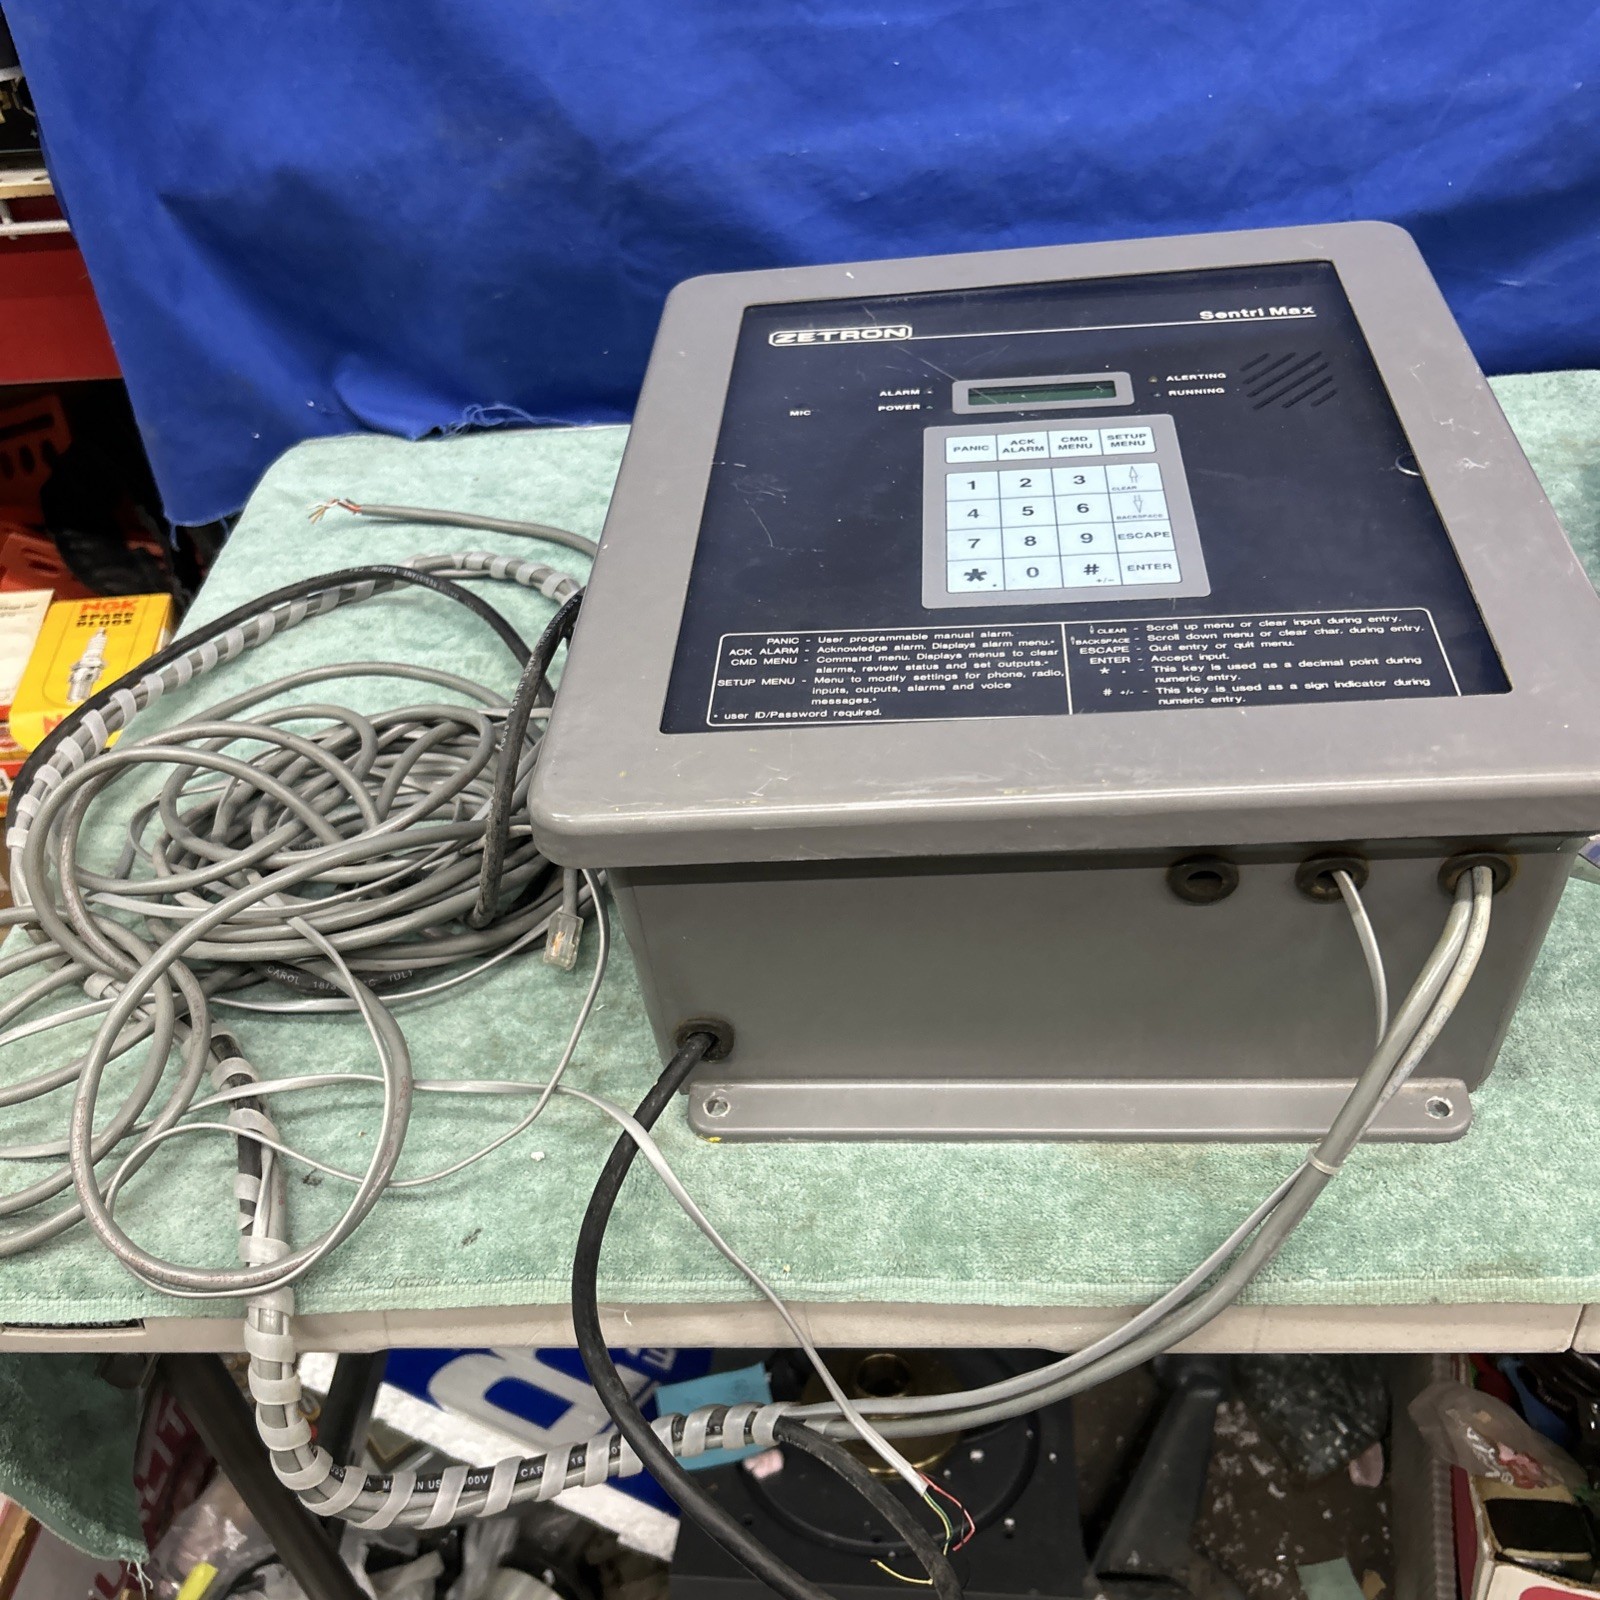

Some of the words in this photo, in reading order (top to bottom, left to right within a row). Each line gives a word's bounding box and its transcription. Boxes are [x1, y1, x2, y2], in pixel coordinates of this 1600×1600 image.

[1200, 308, 1264, 320] Sentri
[1268, 306, 1315, 316] Max
[774, 327, 907, 344] ZETRON
[1166, 372, 1227, 382] ALERTING
[879, 389, 920, 397] ALARM
[1168, 388, 1225, 396] RUNNING
[878, 404, 920, 412] POWER
[1110, 440, 1146, 448] MENU
[1002, 446, 1045, 454] ALARM
[967, 480, 976, 490] 1
[1019, 478, 1032, 488] 2
[1073, 475, 1086, 484] 3
[967, 508, 980, 518] 4
[1022, 506, 1034, 516] 5
[1077, 504, 1089, 514] 6
[1024, 536, 1037, 546] 8
[1080, 533, 1093, 544] 9
[1118, 531, 1171, 540] ESCAPE
[968, 538, 981, 548] 7
[1026, 566, 1039, 578] 0
[1083, 564, 1100, 576] #
[1127, 563, 1172, 572] ENTER
[81, 600, 137, 613] NGK
[1146, 624, 1178, 632] Scroll
[1204, 622, 1234, 630] menu
[1293, 618, 1321, 626] input
[1328, 616, 1362, 625] during
[1368, 615, 1401, 624] entry.
[818, 636, 844, 644] User
[850, 632, 928, 644] programmable
[934, 632, 974, 640] manual
[980, 630, 1014, 638] alarm.
[1076, 638, 1130, 646] BACKSPACE
[1147, 634, 1180, 642] Scroll
[1186, 632, 1217, 640] down
[1260, 630, 1272, 638] or
[1278, 629, 1308, 637] clear
[1314, 628, 1343, 636] char.
[1349, 626, 1384, 635] during
[1390, 624, 1424, 634] entry.
[760, 647, 800, 655] ALARM
[817, 644, 888, 654] Acknowledge
[932, 642, 976, 650] Displays
[982, 640, 1013, 648] alarm
[1080, 646, 1130, 655] ESCAPE
[1149, 644, 1172, 652] Quit
[1178, 643, 1208, 652] entry
[1234, 641, 1254, 650] quit
[1260, 640, 1295, 648] menu.
[730, 658, 757, 666] CMD
[763, 657, 798, 665] MENU
[816, 655, 872, 664] Command
[878, 654, 910, 662] menu.
[916, 651, 962, 660] Displays
[1012, 650, 1024, 658] to
[1090, 656, 1130, 664] ENTER
[1151, 654, 1193, 663] Accept
[1198, 653, 1230, 662] input.
[816, 666, 856, 674] alarms,
[862, 664, 898, 672] review
[905, 662, 940, 670] status
[1152, 664, 1182, 672] This
[1182, 664, 1204, 673] key
[1227, 662, 1256, 670] used
[1298, 659, 1344, 668] decimal
[1350, 658, 1380, 666] point
[1386, 656, 1422, 665] during
[717, 678, 756, 686] SETUP
[761, 678, 796, 686] MENU
[814, 676, 844, 684] Menu
[851, 676, 862, 684] to
[868, 674, 906, 682] modify
[913, 672, 958, 681] settings
[965, 672, 980, 680] for
[987, 670, 1026, 680] phone,
[1155, 675, 1200, 684] numeric
[1206, 674, 1241, 682] entry.
[812, 686, 849, 695] inputs,
[856, 686, 901, 694] outputs,
[907, 684, 946, 692] alarms
[952, 682, 974, 690] and
[981, 682, 1012, 690] voice
[1102, 688, 1112, 696] #
[1156, 686, 1185, 694] This
[1186, 686, 1208, 694] key
[1216, 684, 1226, 692] is
[1232, 683, 1262, 692] used
[1290, 682, 1298, 690] a
[1304, 682, 1329, 690] sign
[1334, 679, 1386, 688] indicator
[1394, 678, 1431, 687] during
[1158, 696, 1204, 705] numeric
[1211, 695, 1246, 704] entry.
[724, 712, 750, 720] user
[755, 710, 828, 719] ID/Password
[833, 709, 882, 718] required.
